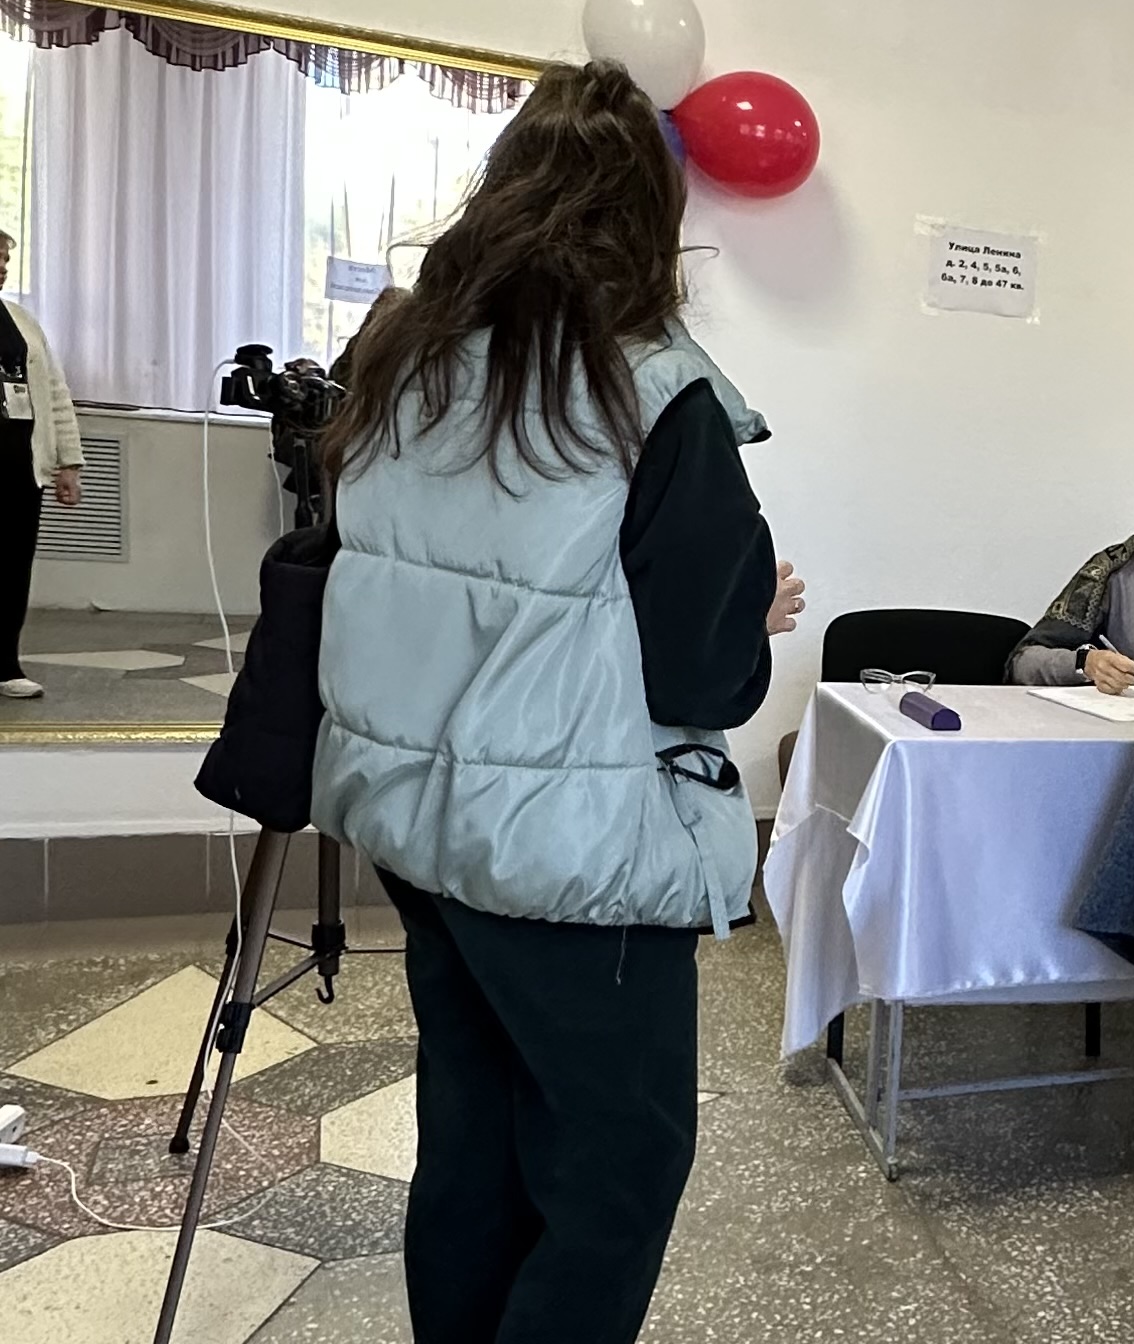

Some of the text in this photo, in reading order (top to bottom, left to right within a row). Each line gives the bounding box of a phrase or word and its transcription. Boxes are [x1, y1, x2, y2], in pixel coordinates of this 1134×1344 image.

[949, 242, 1021, 259] Улица Ленина
[959, 260, 968, 270] 2,
[970, 261, 980, 271] 4,
[983, 263, 992, 273] 5,
[995, 264, 1010, 275] 5а,
[1012, 266, 1021, 276] 6,
[941, 273, 957, 284] 6а,
[960, 275, 969, 285] 7,
[972, 276, 978, 285] 8
[980, 279, 993, 287] до
[995, 279, 1008, 288] 47
